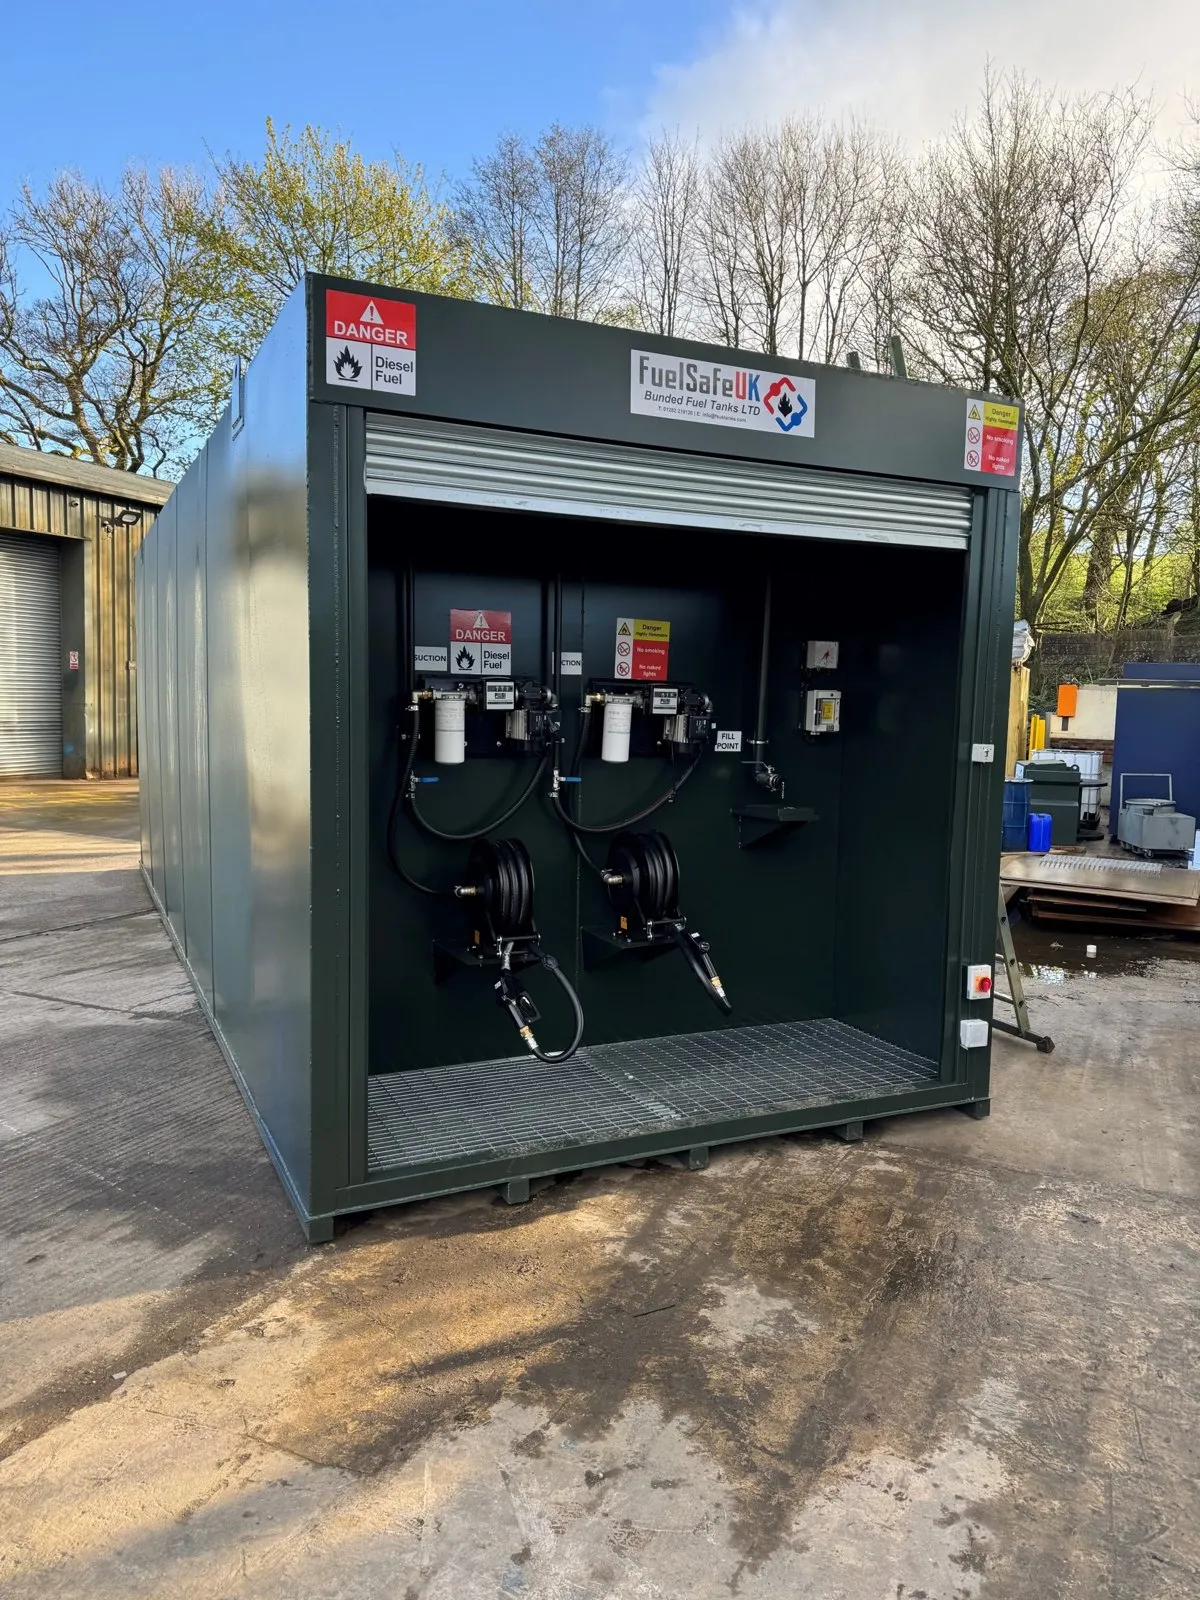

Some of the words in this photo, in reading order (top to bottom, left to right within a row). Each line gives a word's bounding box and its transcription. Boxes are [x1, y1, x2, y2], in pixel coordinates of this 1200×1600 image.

[334, 320, 408, 346] DANGER
[375, 356, 413, 373] Diesel
[375, 370, 402, 385] Fuel
[639, 355, 760, 402] FuelSafeUK
[644, 390, 684, 405] Bunded
[686, 396, 707, 409] Fuel
[711, 400, 739, 413] Tanks
[741, 404, 761, 416] LTD
[992, 408, 1011, 418] Danger
[995, 436, 1013, 446] smoking
[642, 624, 662, 632] Danger
[455, 629, 506, 642] DANGER
[414, 654, 447, 662] SUCTION
[483, 650, 510, 660] Diesel
[483, 660, 502, 669] Fuel
[721, 732, 736, 740] FILL
[716, 742, 739, 750] POINT
